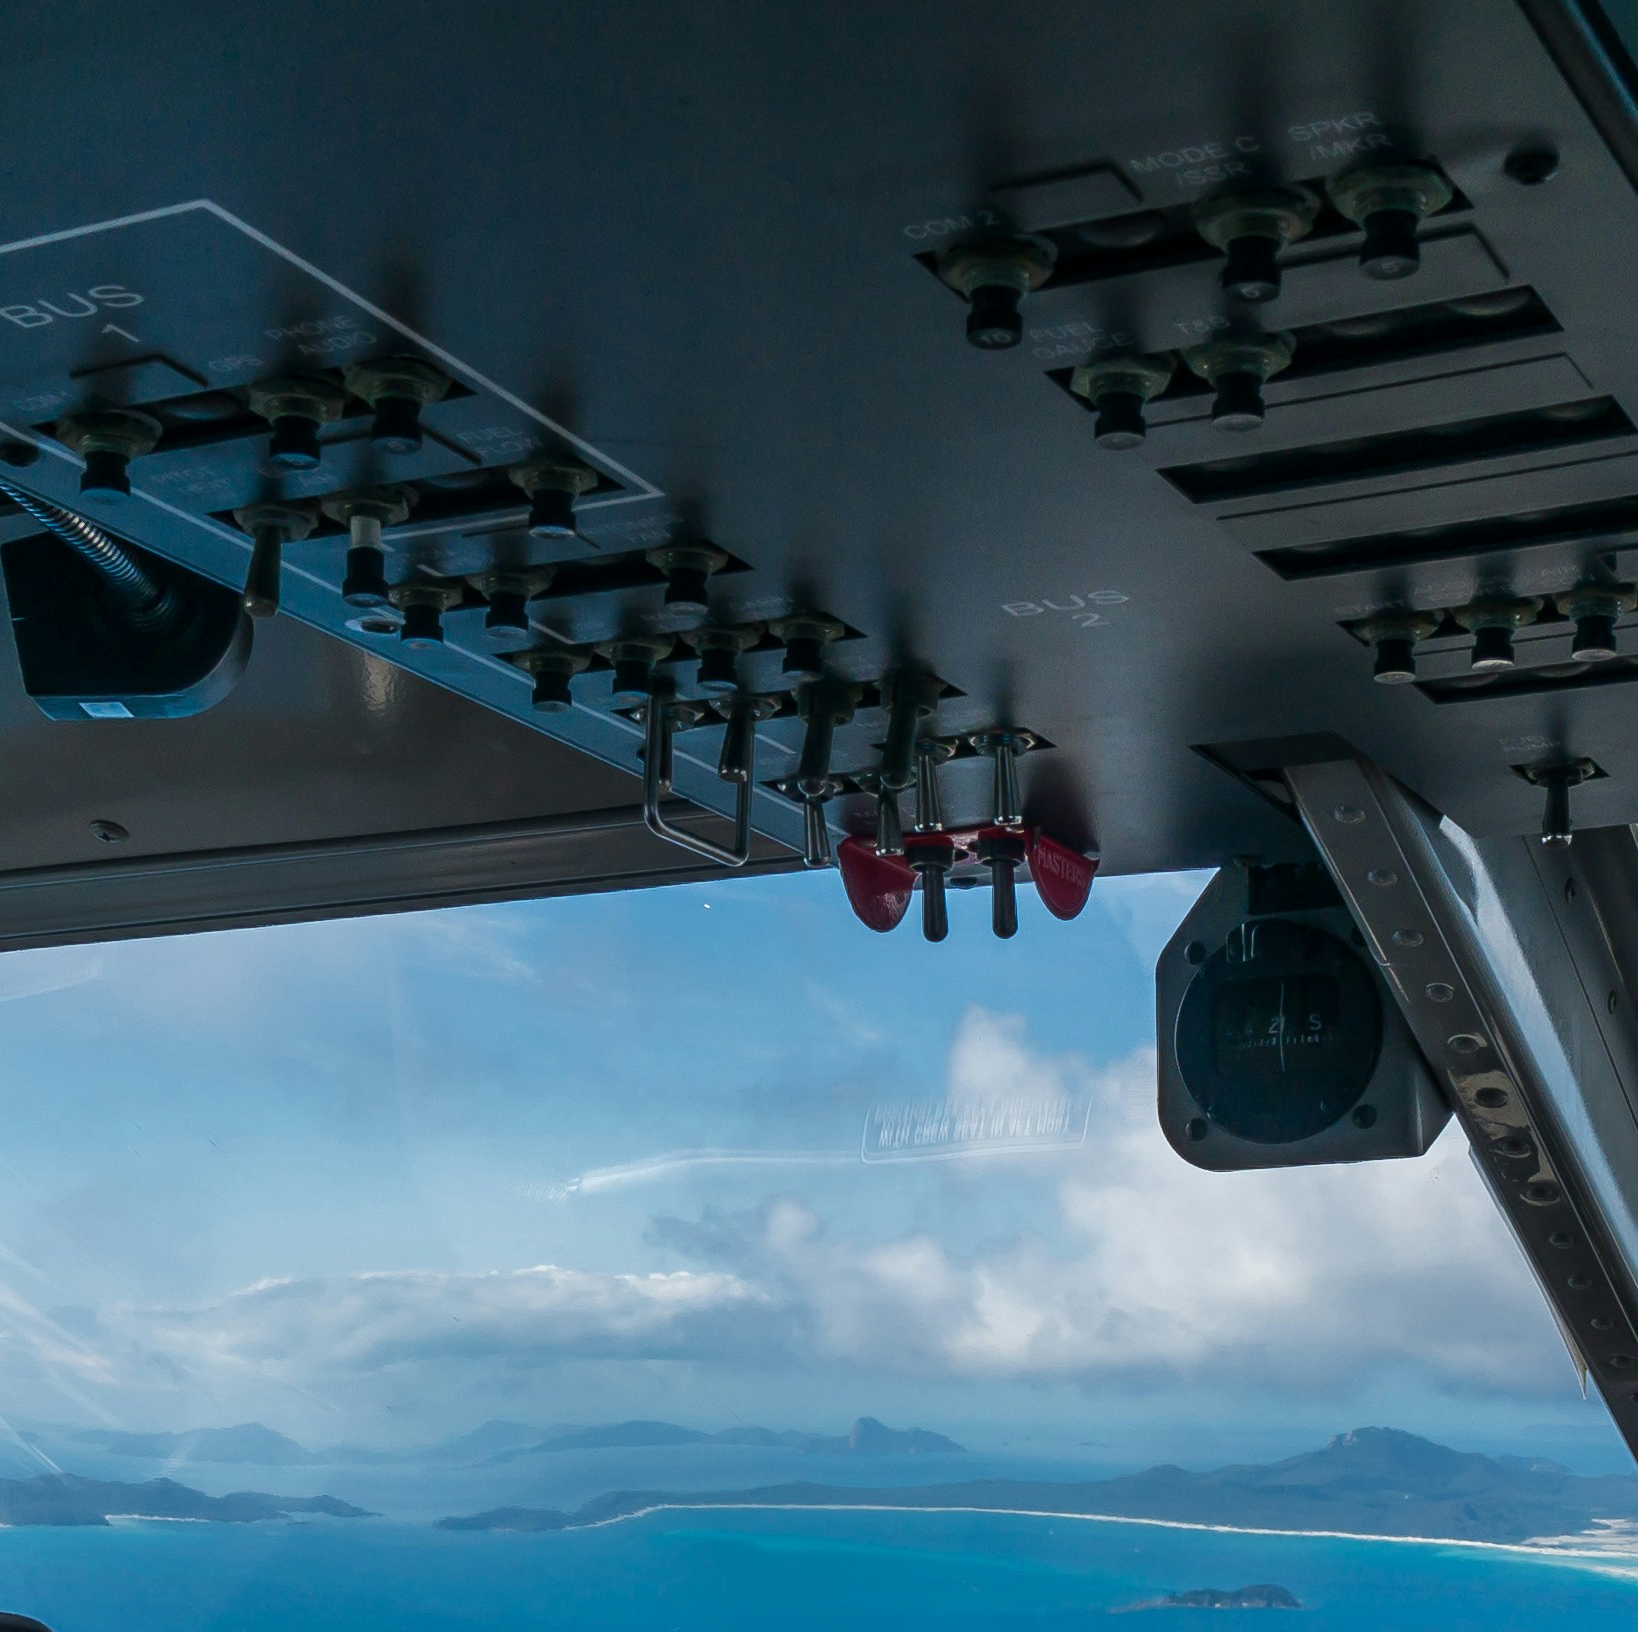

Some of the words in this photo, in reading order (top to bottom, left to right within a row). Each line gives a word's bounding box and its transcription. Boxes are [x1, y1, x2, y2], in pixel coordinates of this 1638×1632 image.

[1288, 111, 1382, 143] SPKR
[1128, 145, 1231, 174] MODE
[1235, 136, 1259, 153] C
[903, 216, 970, 240] COM
[973, 212, 1000, 228] 2
[102, 323, 142, 343] 1
[265, 314, 359, 342] PHONE
[299, 330, 377, 355] AUDIO
[1000, 589, 1129, 618] BUS
[1071, 612, 1109, 628] 2
